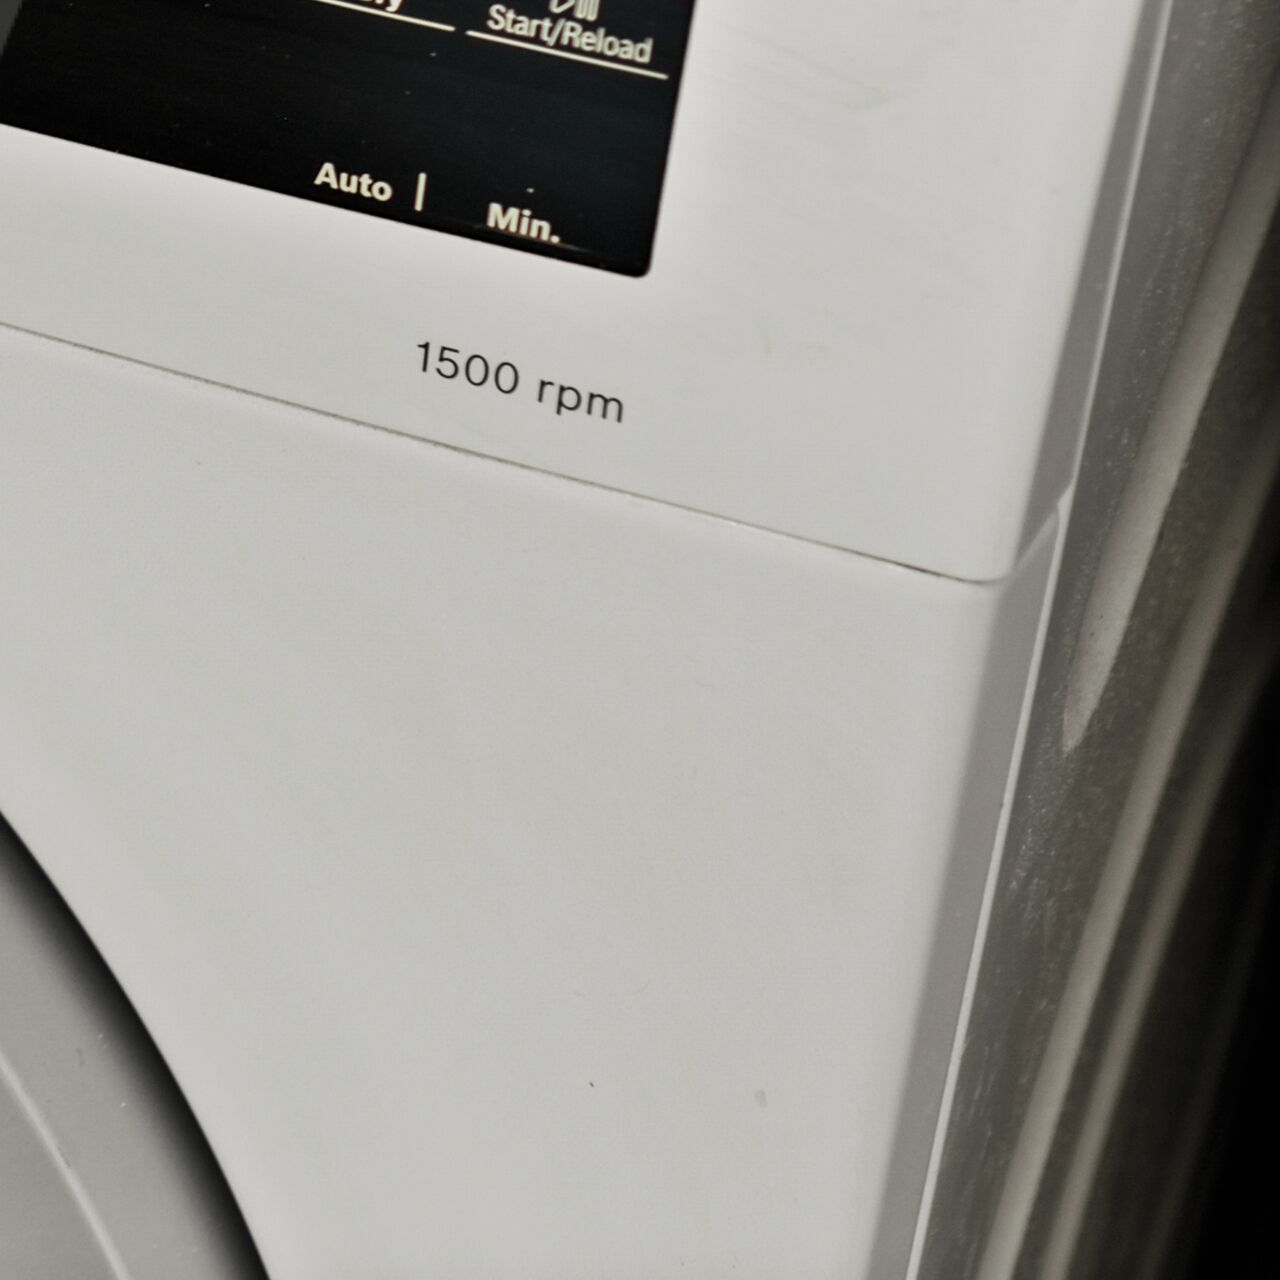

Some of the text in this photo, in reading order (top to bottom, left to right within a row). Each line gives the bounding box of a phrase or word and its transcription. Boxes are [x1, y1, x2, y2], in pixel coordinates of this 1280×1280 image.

[488, 4, 654, 65] Start/Reload
[314, 162, 392, 202] Auto
[487, 202, 561, 244] Min.
[416, 341, 624, 423] 1500 rpm
